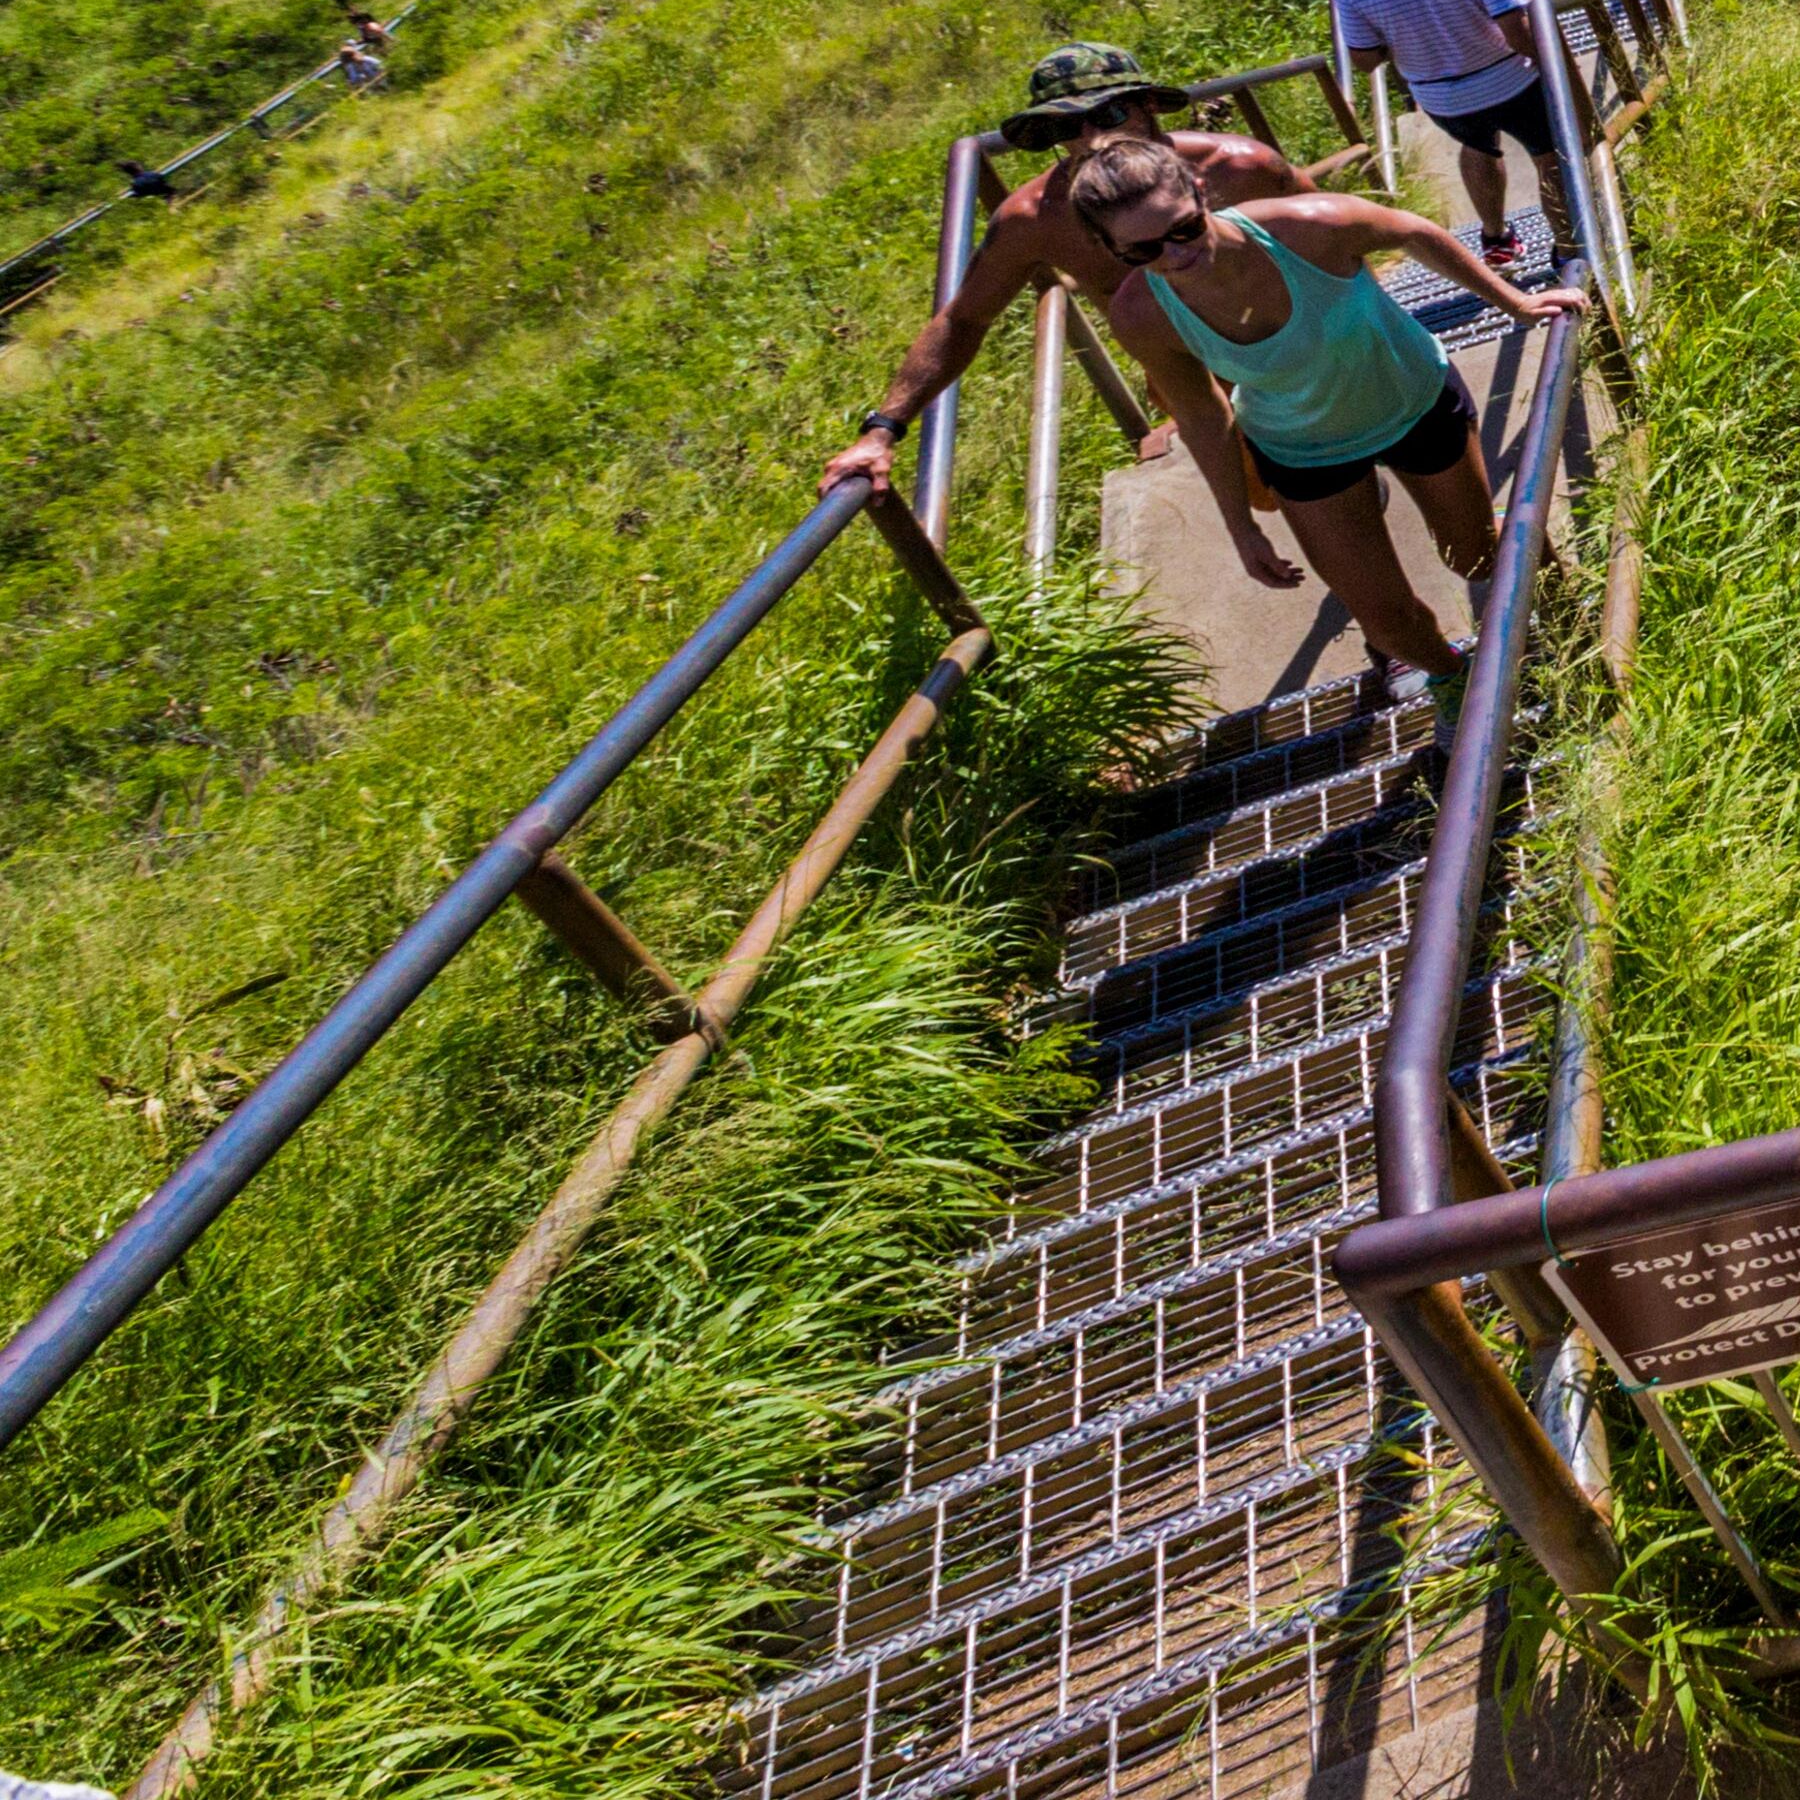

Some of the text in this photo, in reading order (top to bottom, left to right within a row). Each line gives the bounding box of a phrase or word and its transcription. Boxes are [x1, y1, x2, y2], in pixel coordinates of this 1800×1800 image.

[1610, 1251, 1694, 1279] Stay
[1661, 1267, 1717, 1289] for
[1675, 1293, 1717, 1309] to
[1634, 1330, 1770, 1371] Protect
